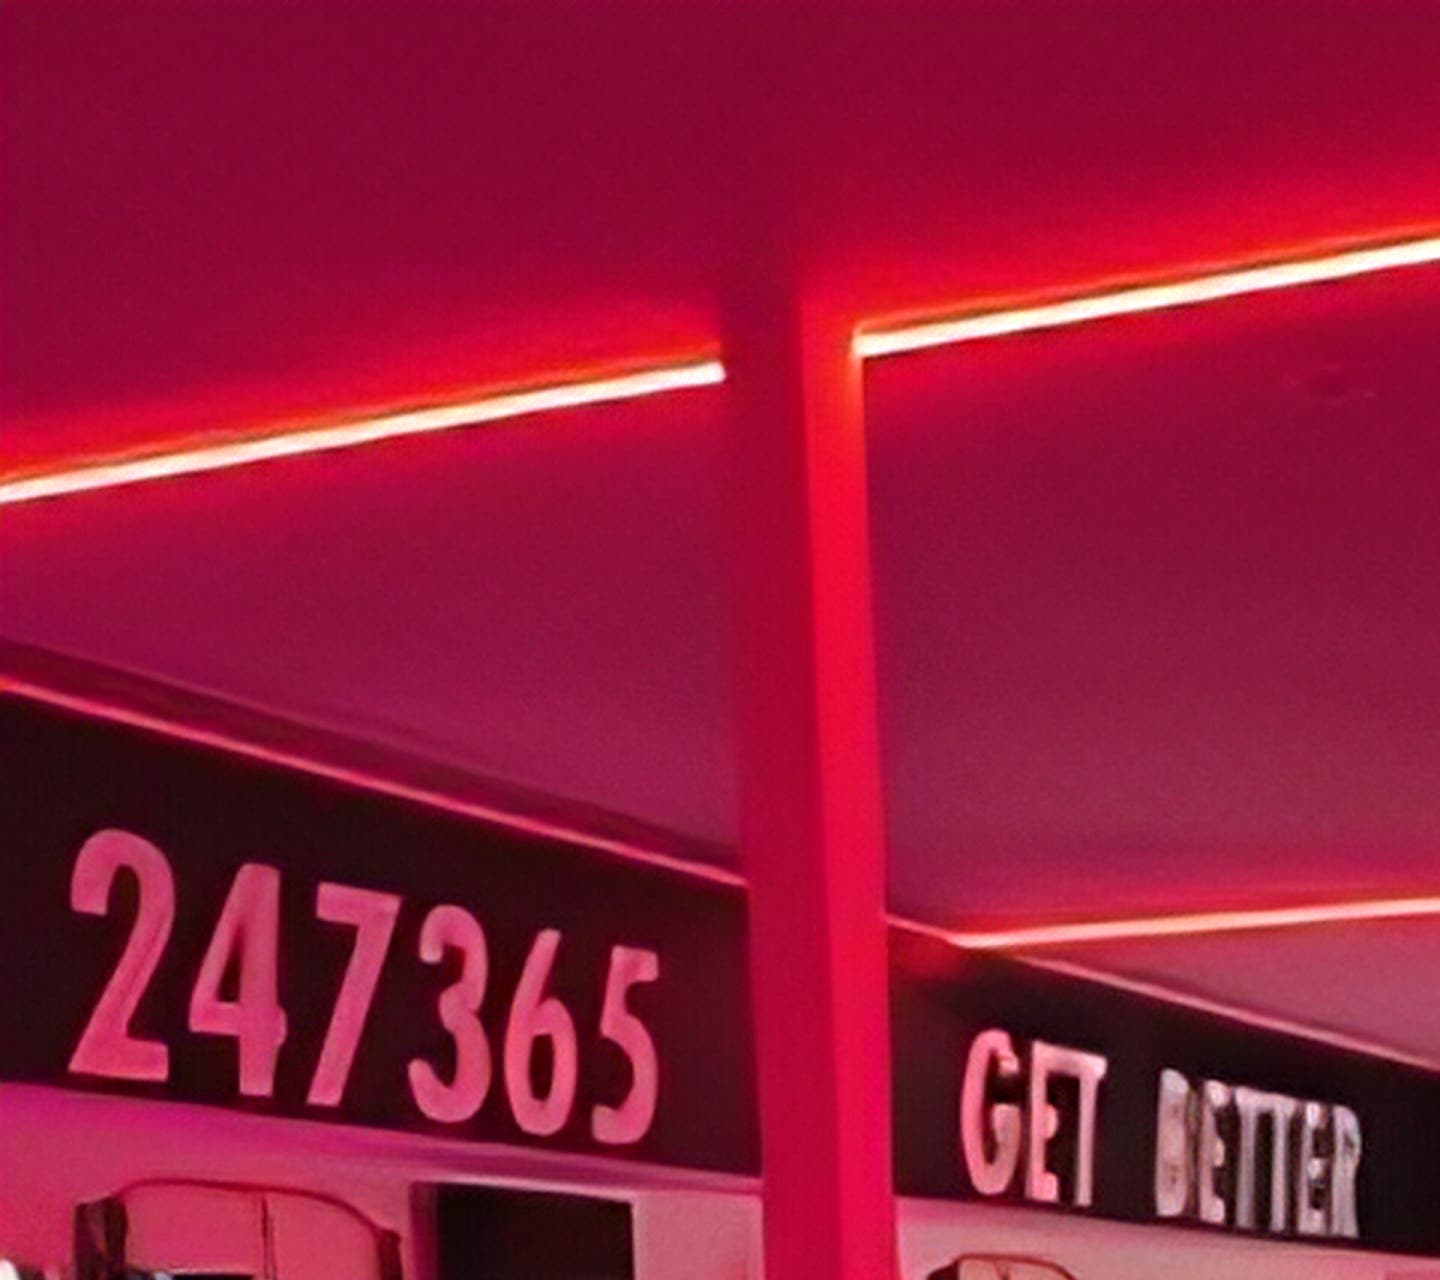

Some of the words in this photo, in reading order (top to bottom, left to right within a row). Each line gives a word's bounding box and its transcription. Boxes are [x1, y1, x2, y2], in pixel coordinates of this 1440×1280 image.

[68, 828, 659, 1145] 247365
[960, 1029, 1107, 1207] GET
[1155, 1068, 1362, 1238] BETTER
